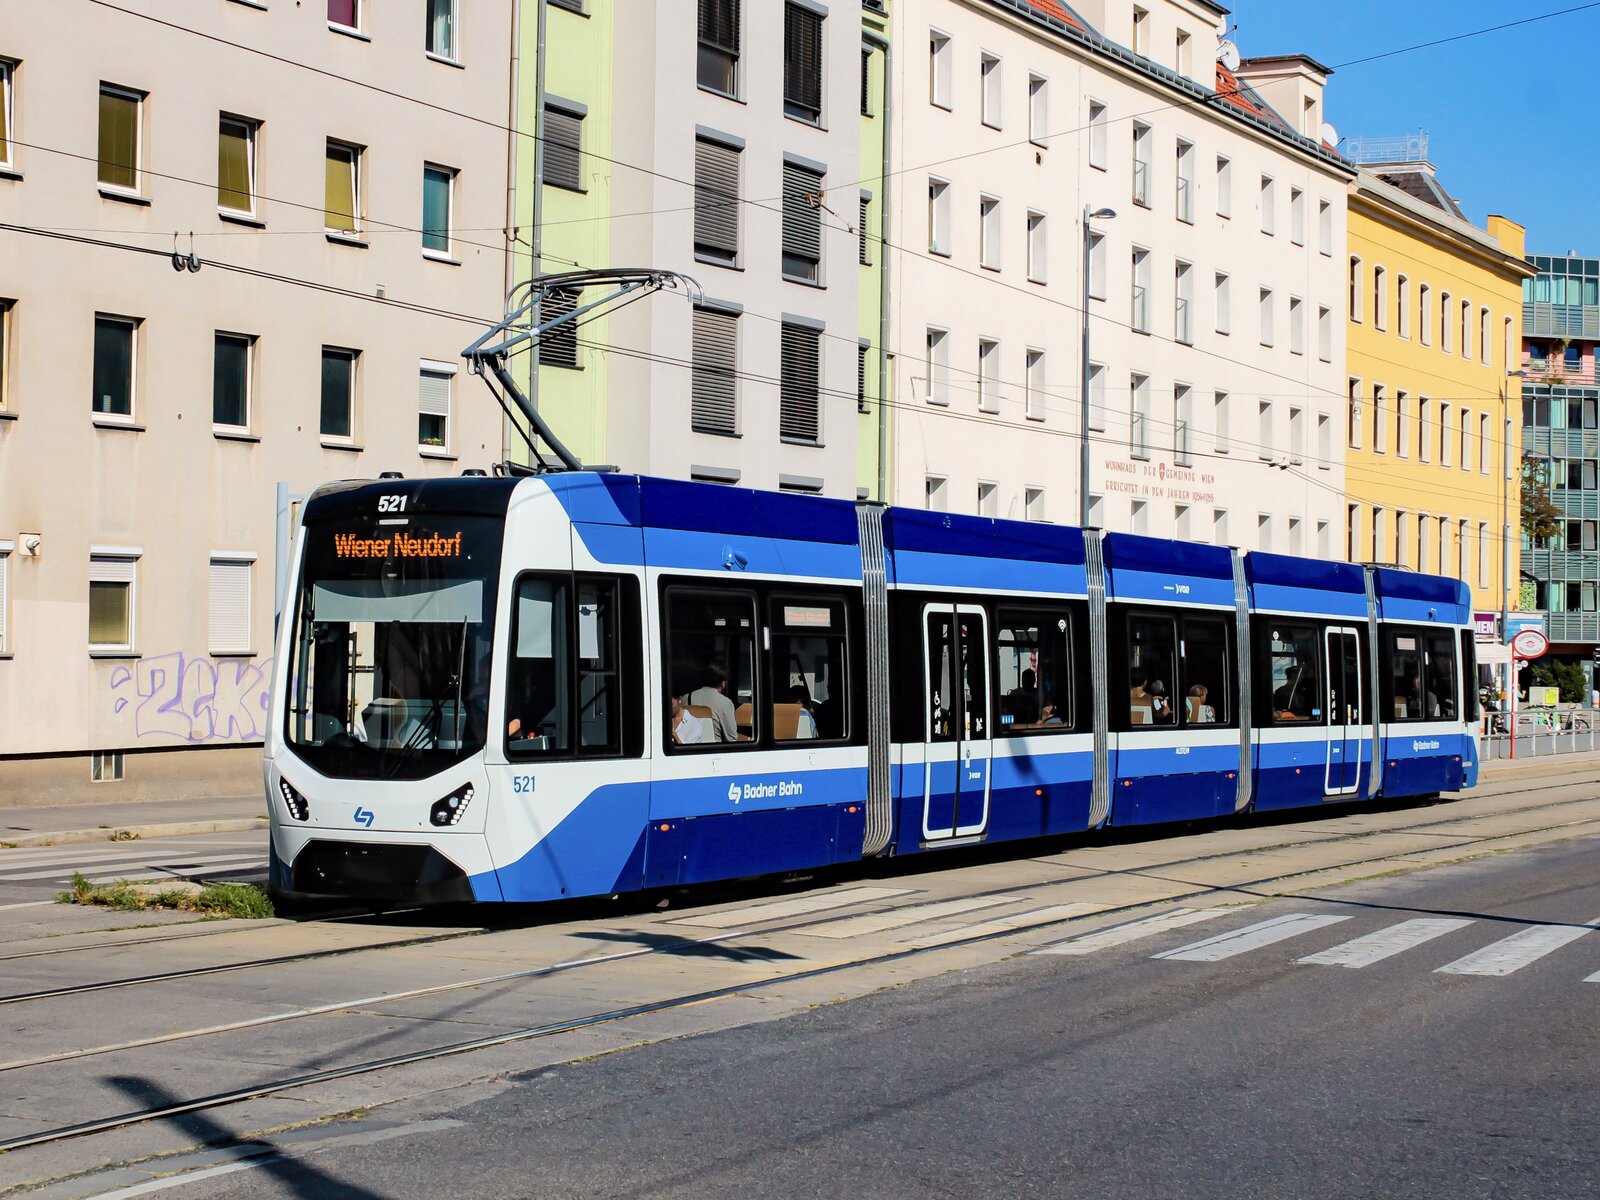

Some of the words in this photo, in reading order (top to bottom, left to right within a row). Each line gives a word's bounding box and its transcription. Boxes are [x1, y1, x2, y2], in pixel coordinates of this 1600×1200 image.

[1105, 460, 1136, 474] WOHNHAUS
[1143, 465, 1157, 476] DER
[1166, 468, 1195, 482] GEMEINDE
[1201, 473, 1215, 484] WIEN
[1105, 480, 1138, 494] ERRICHTET
[1142, 485, 1149, 495] IN
[1152, 486, 1163, 497] DEN
[1167, 488, 1190, 500] JAHREN
[378, 495, 408, 512] 521
[334, 533, 391, 558] Wiener
[394, 531, 462, 557] Neudorf
[513, 775, 535, 793] 521
[743, 782, 778, 799] Badner
[779, 780, 802, 796] Bahn
